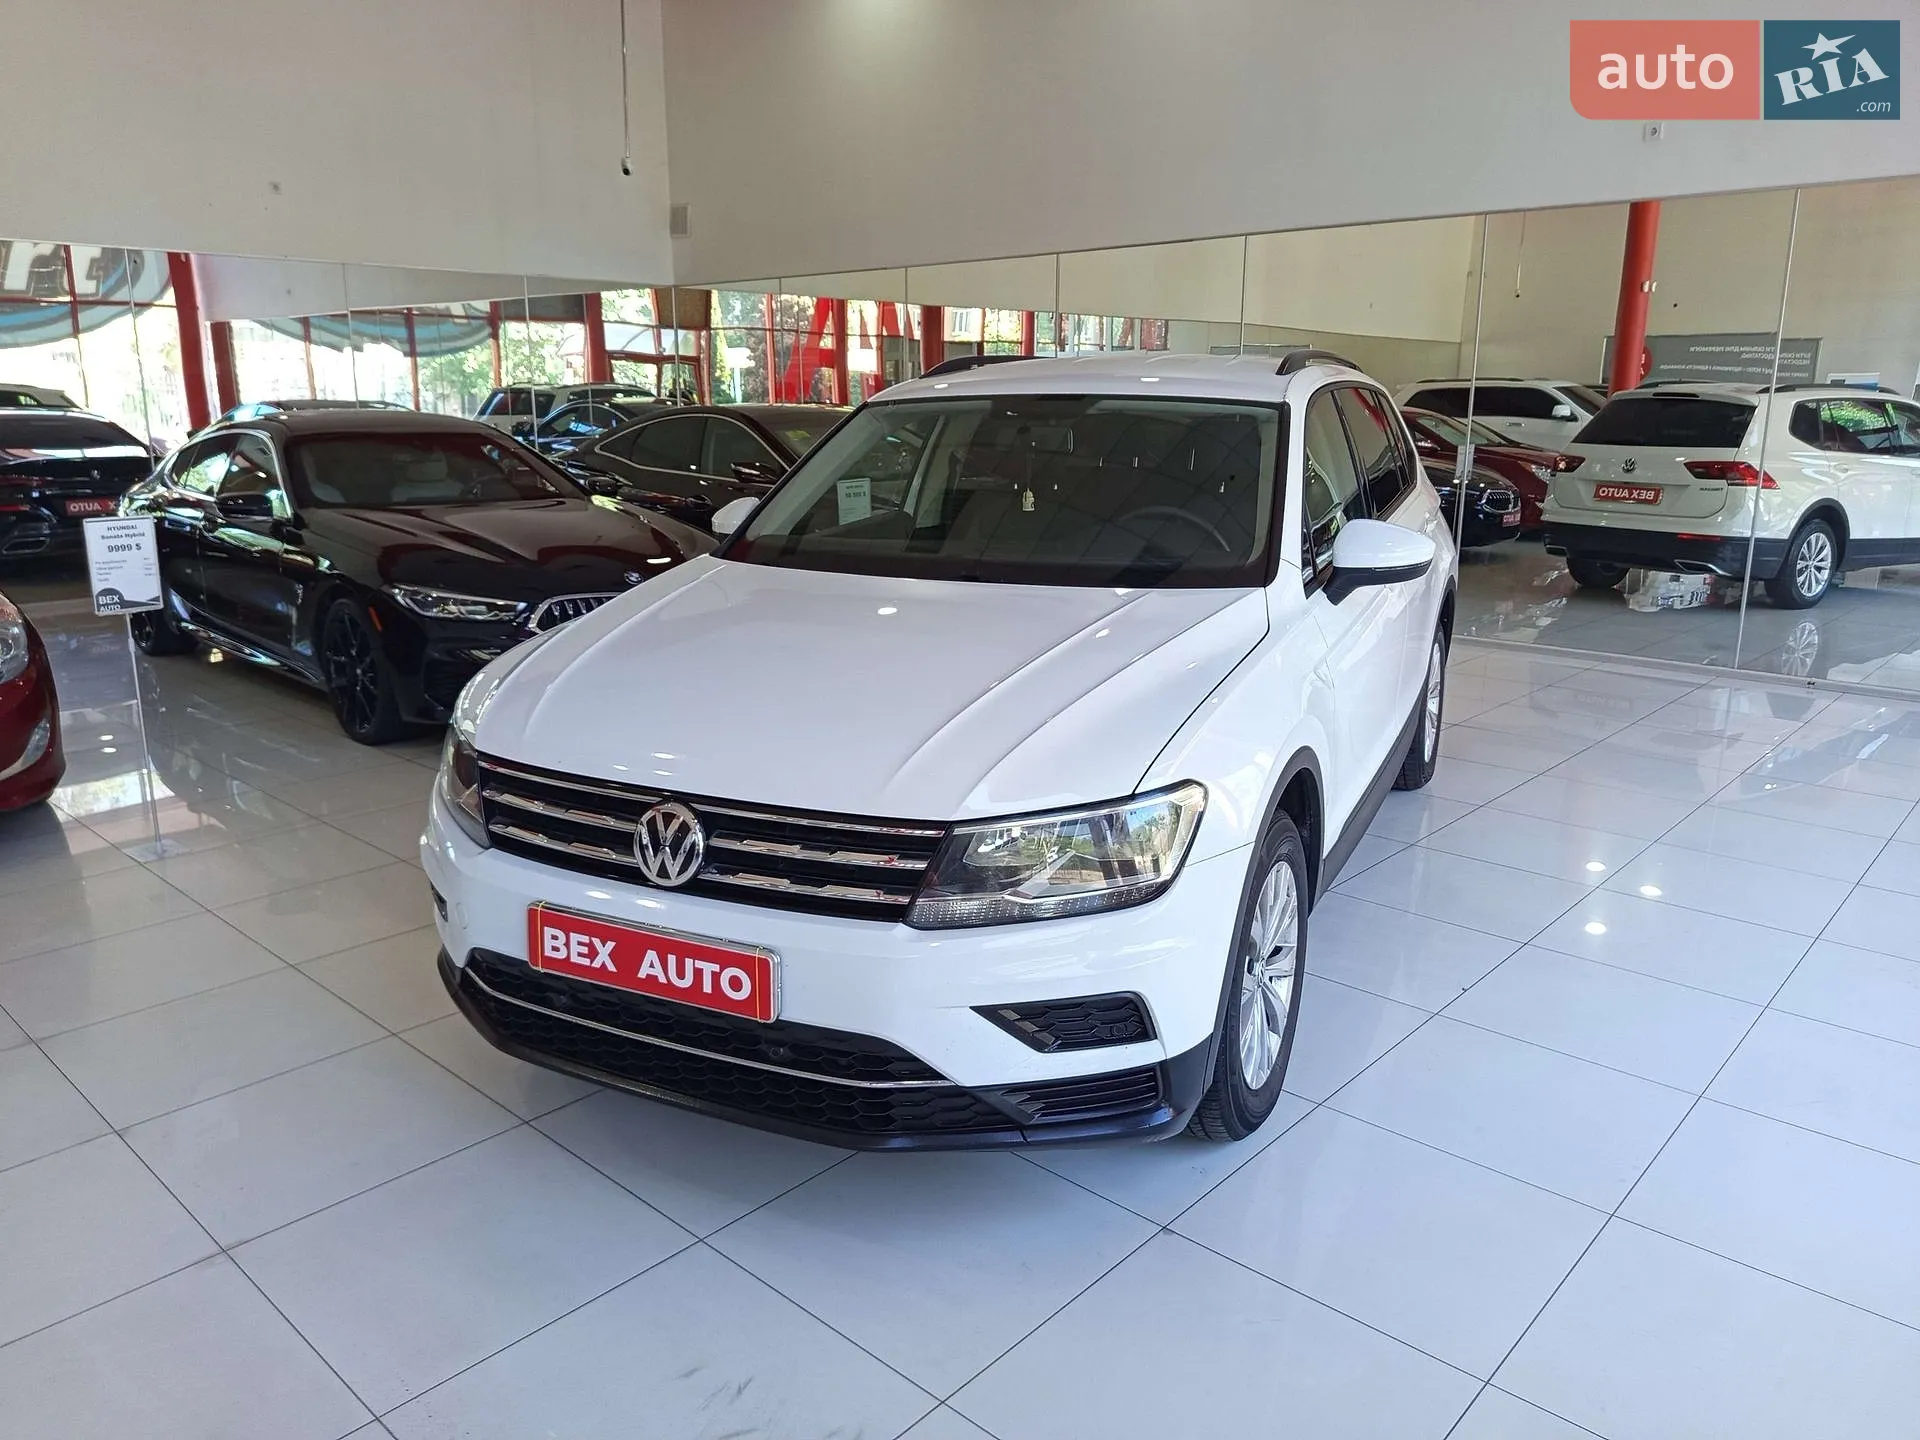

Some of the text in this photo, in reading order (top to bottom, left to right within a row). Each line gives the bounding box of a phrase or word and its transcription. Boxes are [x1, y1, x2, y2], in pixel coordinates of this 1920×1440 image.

[107, 524, 138, 532] HYUNDAI
[107, 542, 142, 553] 9999 $
[99, 594, 120, 605] BEX
[100, 604, 121, 612] AUTO
[543, 926, 752, 1001] BEX AUTO
